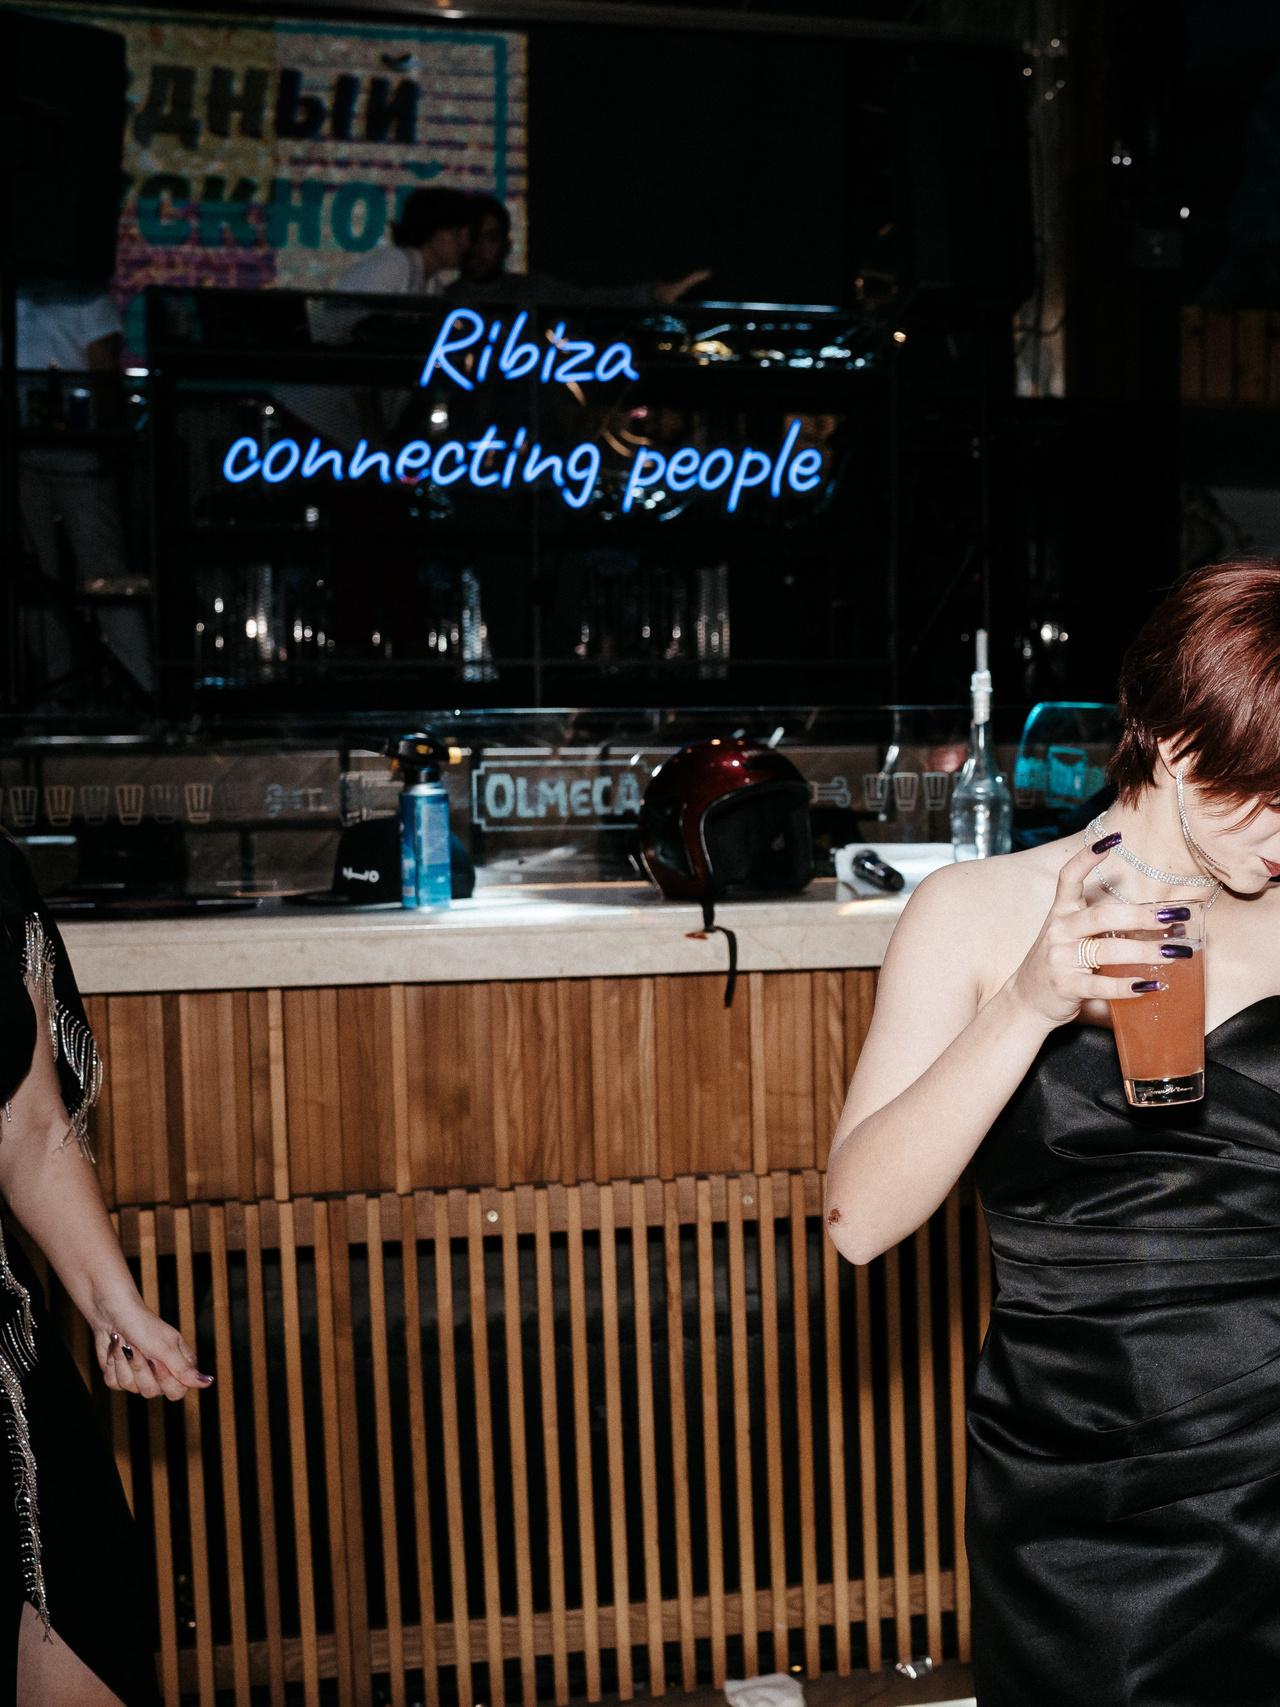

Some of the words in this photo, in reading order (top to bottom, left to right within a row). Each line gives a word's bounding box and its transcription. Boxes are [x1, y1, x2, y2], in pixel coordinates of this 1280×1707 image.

[128, 53, 420, 150] ДНЫЙ
[130, 162, 440, 250] СКНО
[421, 308, 639, 391] Ribiza
[223, 425, 602, 509] connecting
[622, 420, 822, 513] people
[485, 773, 641, 818] OLMECA
